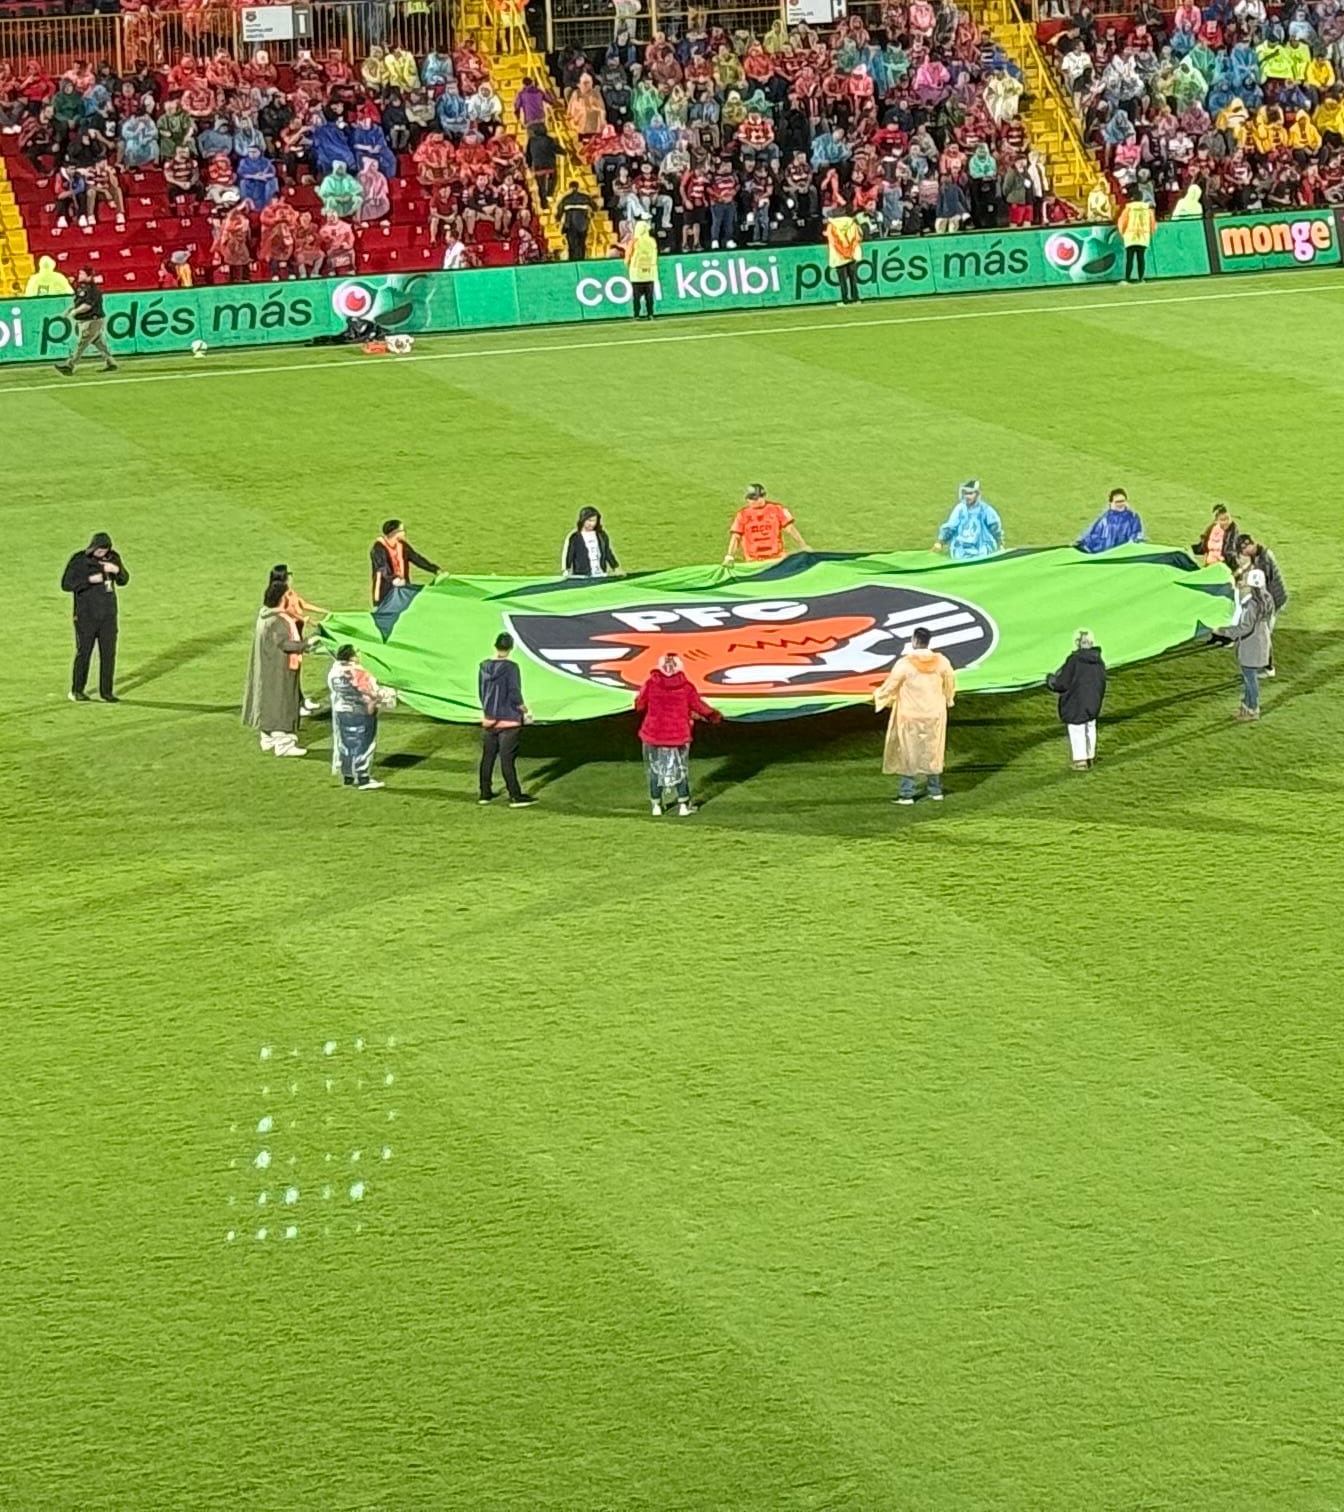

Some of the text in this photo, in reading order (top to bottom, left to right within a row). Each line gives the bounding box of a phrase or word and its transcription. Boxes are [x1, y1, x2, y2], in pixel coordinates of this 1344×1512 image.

[832, 0, 847, 19] H
[1220, 219, 1331, 261] monge
[576, 273, 662, 307] co
[675, 256, 781, 298] kölbi
[943, 240, 1029, 279] más
[40, 296, 195, 355] pdés
[213, 288, 314, 332] más
[611, 599, 810, 632] PFC
